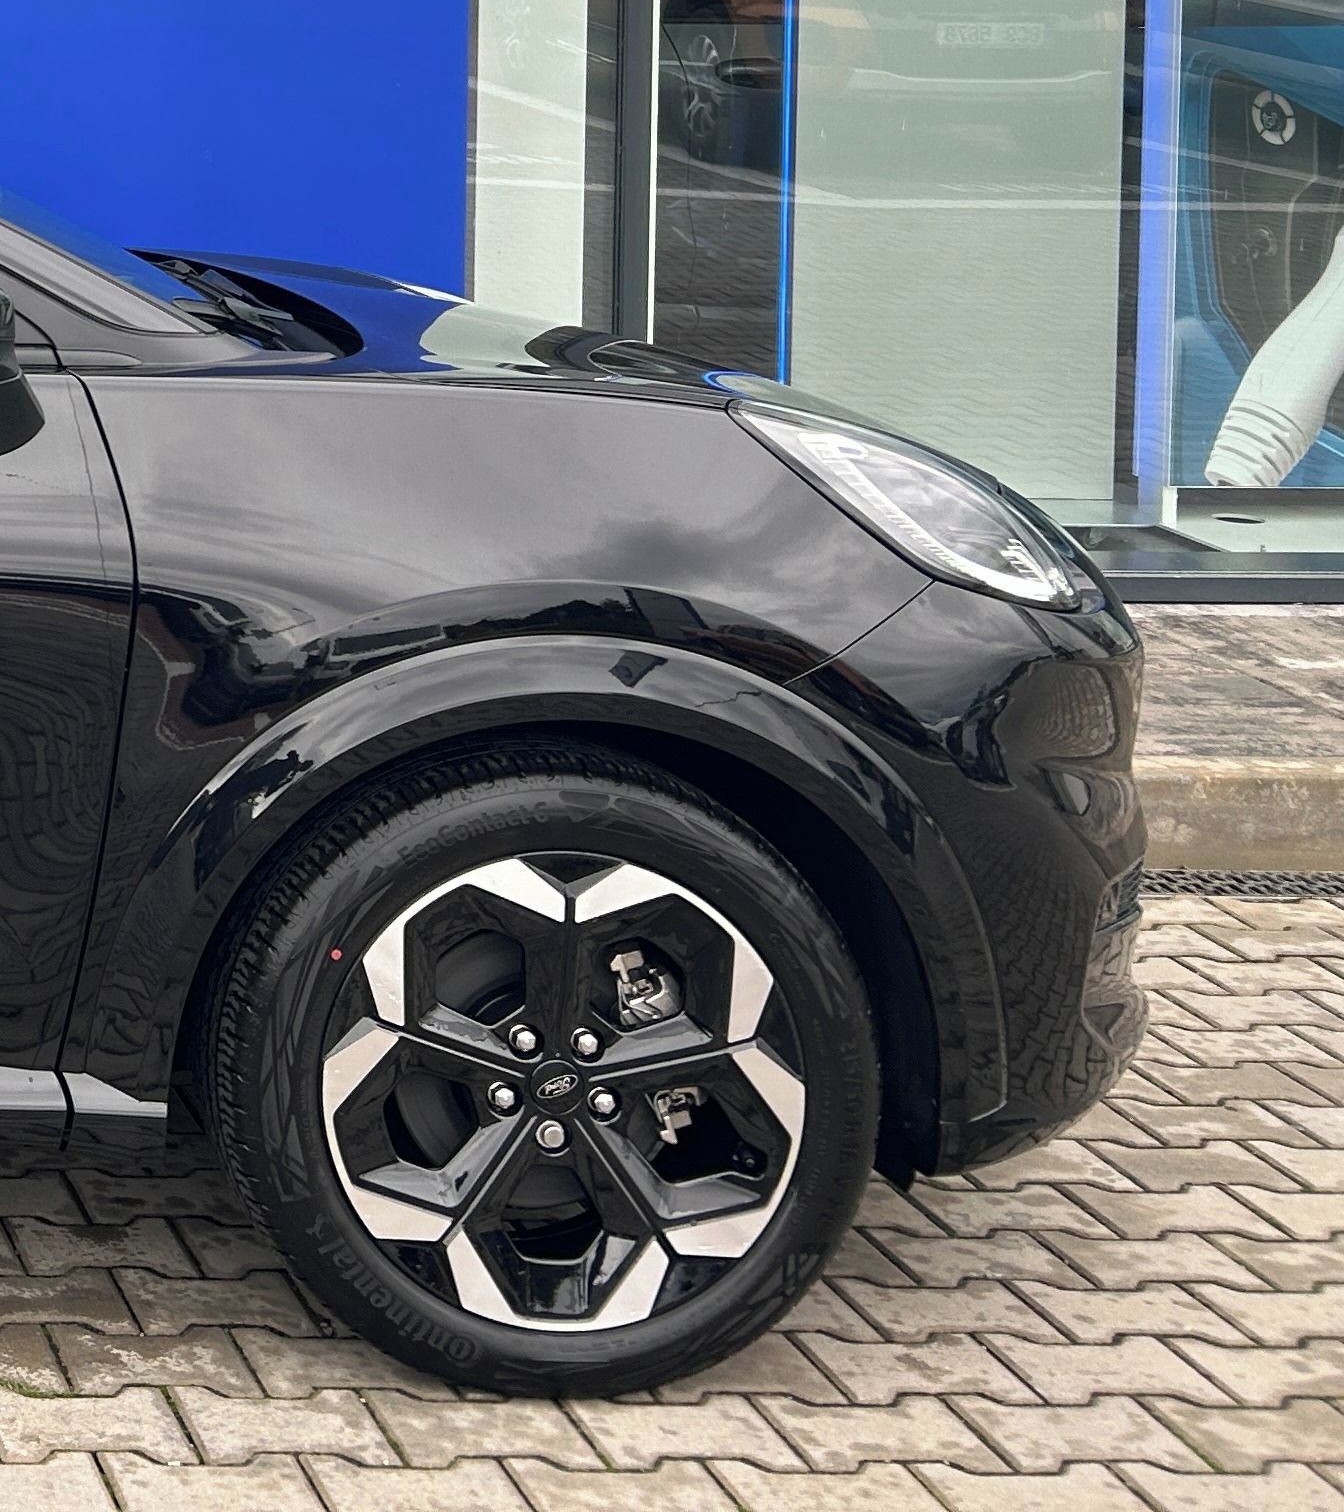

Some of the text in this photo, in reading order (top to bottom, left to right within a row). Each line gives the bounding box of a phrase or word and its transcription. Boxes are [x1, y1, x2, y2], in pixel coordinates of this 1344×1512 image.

[397, 801, 549, 869] EcoContact 6
[318, 1237, 481, 1368] Continental
